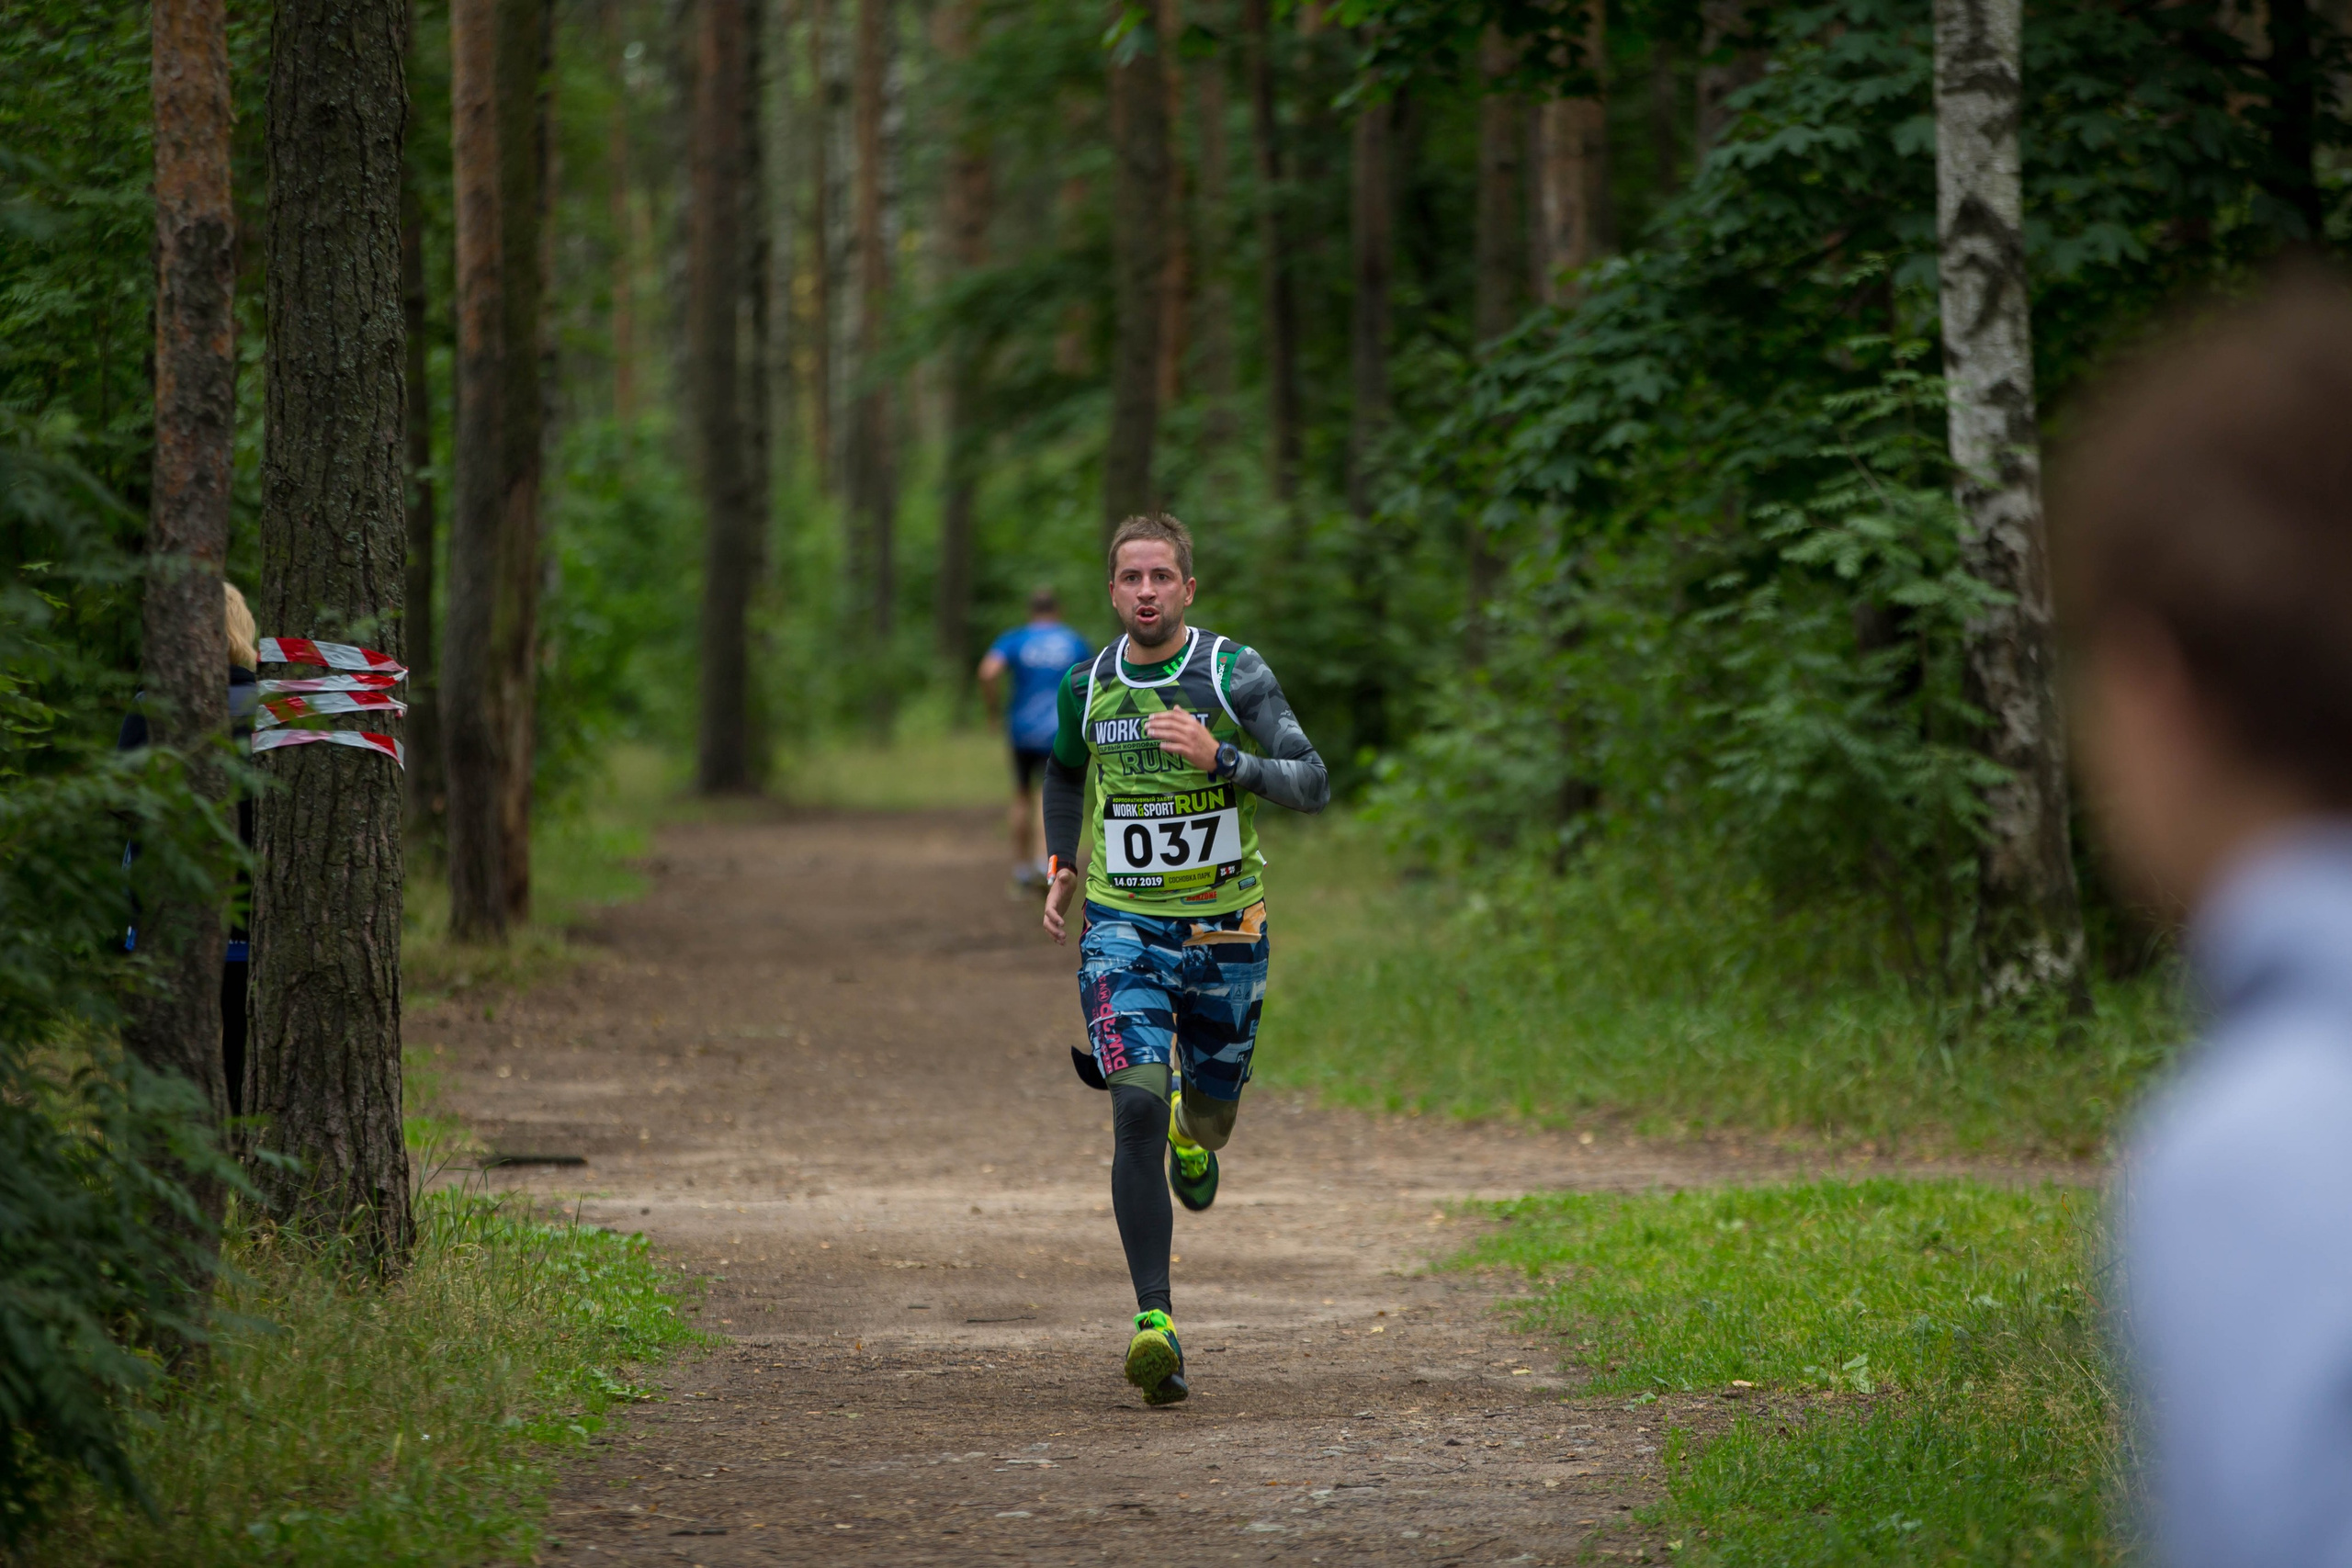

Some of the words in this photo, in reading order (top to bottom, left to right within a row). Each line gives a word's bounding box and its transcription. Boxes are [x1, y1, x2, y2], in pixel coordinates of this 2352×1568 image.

[1121, 749, 1183, 775] RUN
[1113, 802, 1174, 817] WORK&SPORT
[1175, 788, 1226, 814] RUN
[1124, 816, 1221, 868] 037
[1114, 876, 1163, 886] 14.07.2019
[1168, 874, 1197, 884] СОСНОВКА
